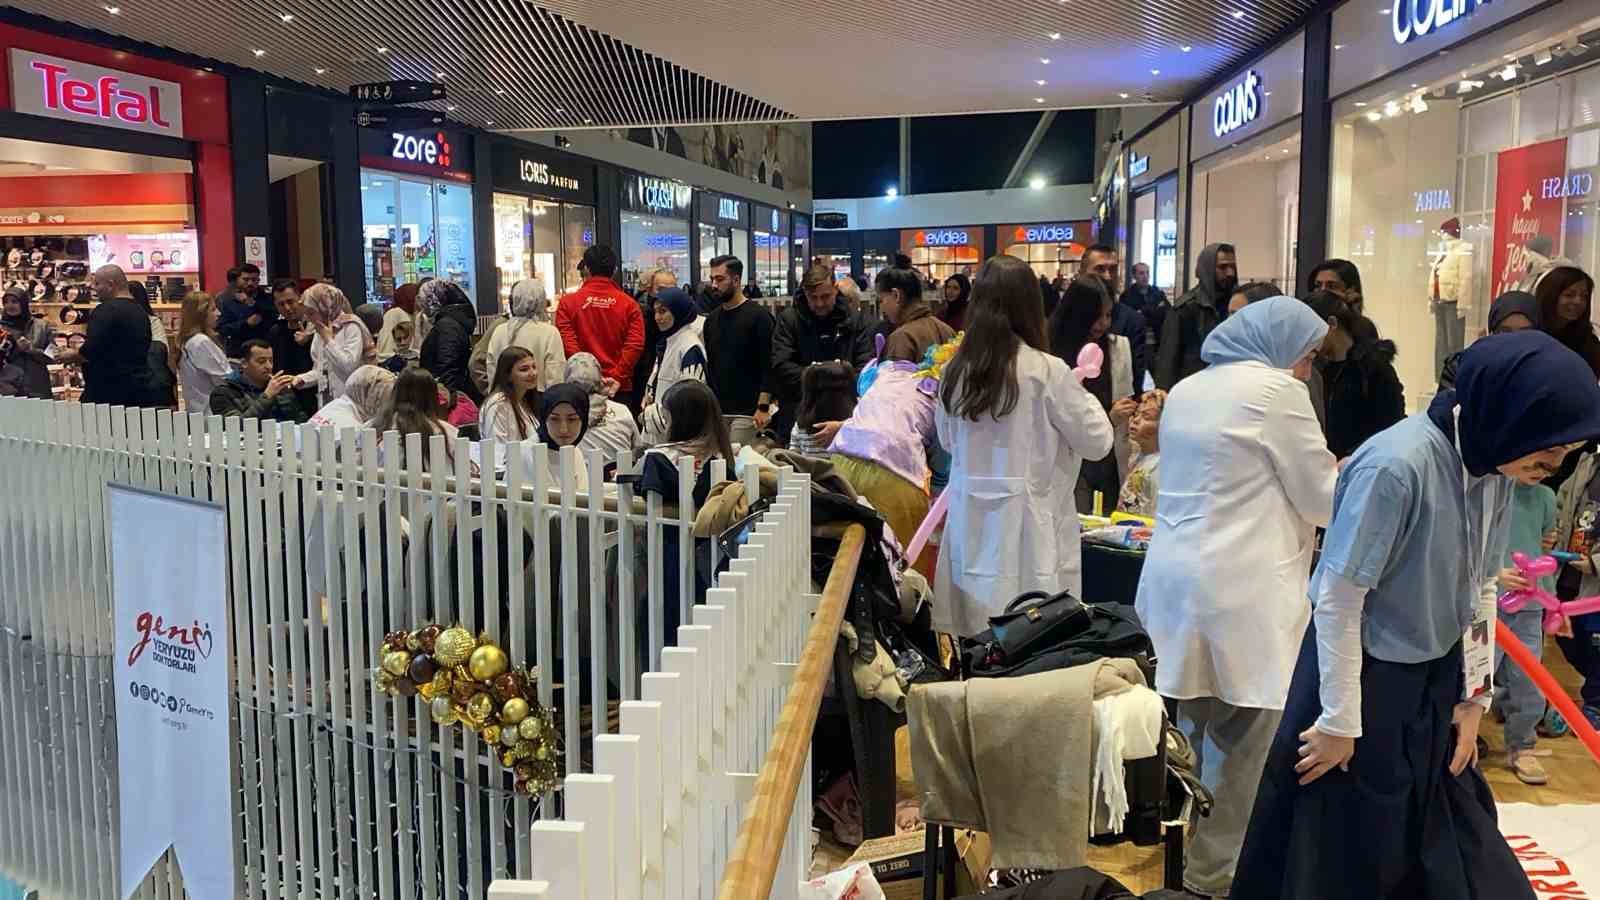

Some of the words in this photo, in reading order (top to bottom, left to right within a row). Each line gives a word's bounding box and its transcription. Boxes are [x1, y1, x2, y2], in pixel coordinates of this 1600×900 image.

[32, 60, 170, 128] Tefal
[1214, 70, 1257, 137] COLIN'S
[391, 132, 437, 165] zore
[520, 159, 548, 185] LORIS
[550, 175, 579, 190] PARFUM
[646, 186, 674, 209] CRASH
[926, 230, 967, 245] evidea
[1026, 225, 1073, 241] evidea
[1511, 213, 1540, 240] happy
[877, 863, 888, 873] TO
